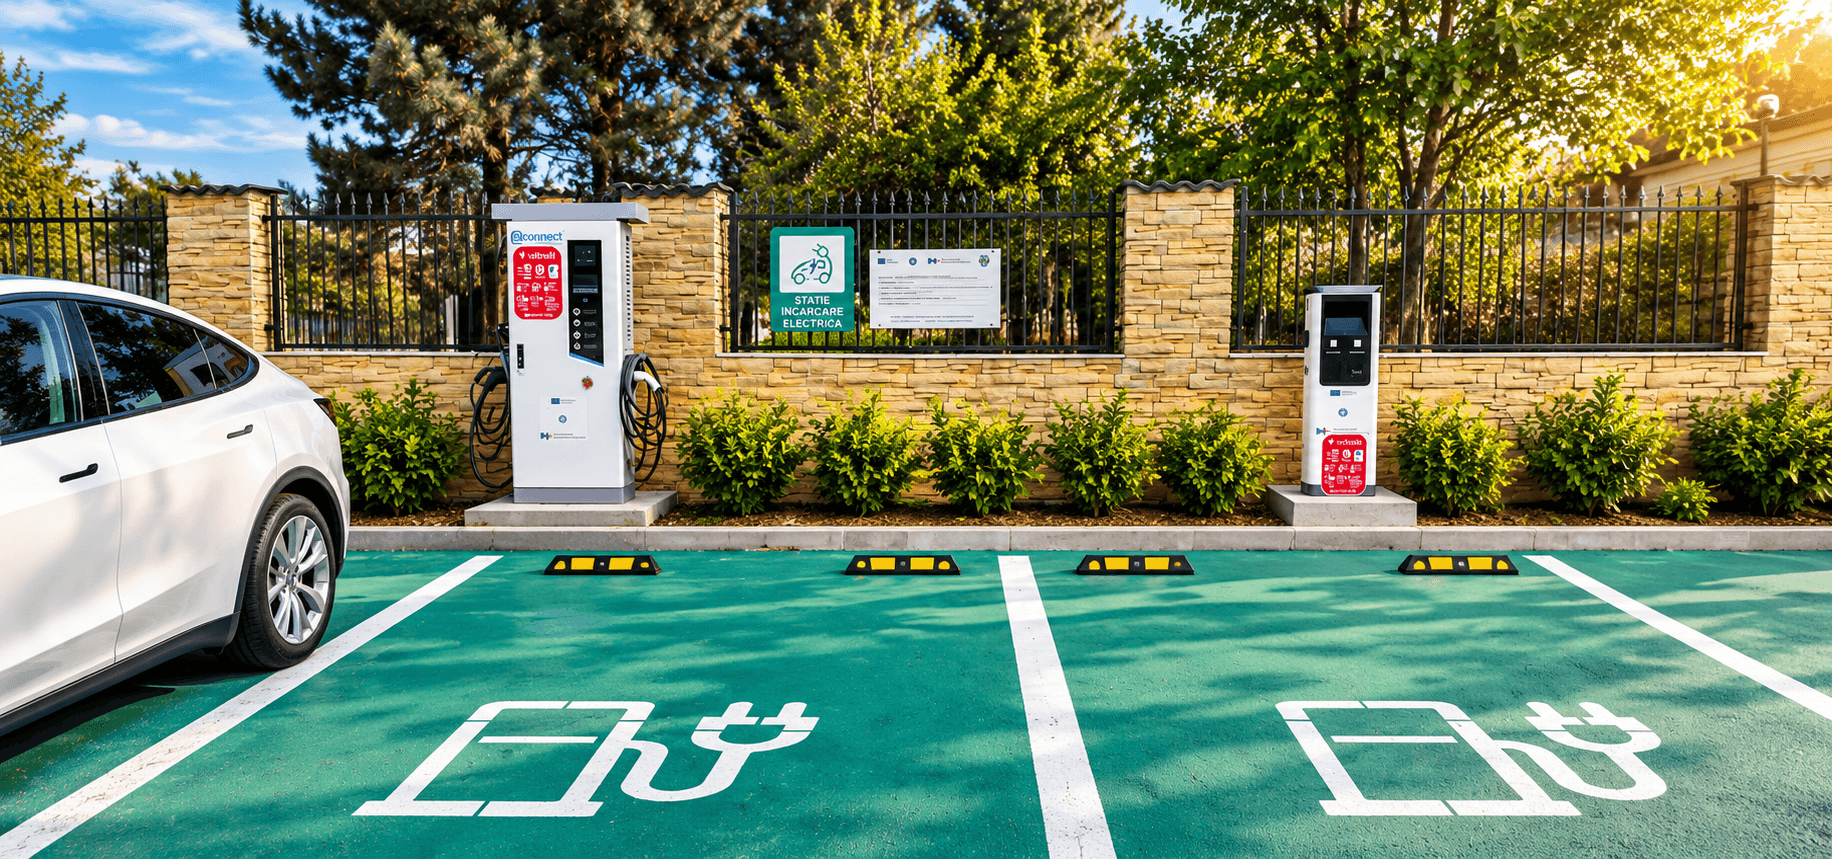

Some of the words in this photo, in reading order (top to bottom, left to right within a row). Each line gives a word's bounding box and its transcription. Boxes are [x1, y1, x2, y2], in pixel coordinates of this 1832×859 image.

[794, 295, 830, 305] STATIE
[781, 306, 844, 316] INCARCARE
[783, 319, 843, 328] ELECTRICA
